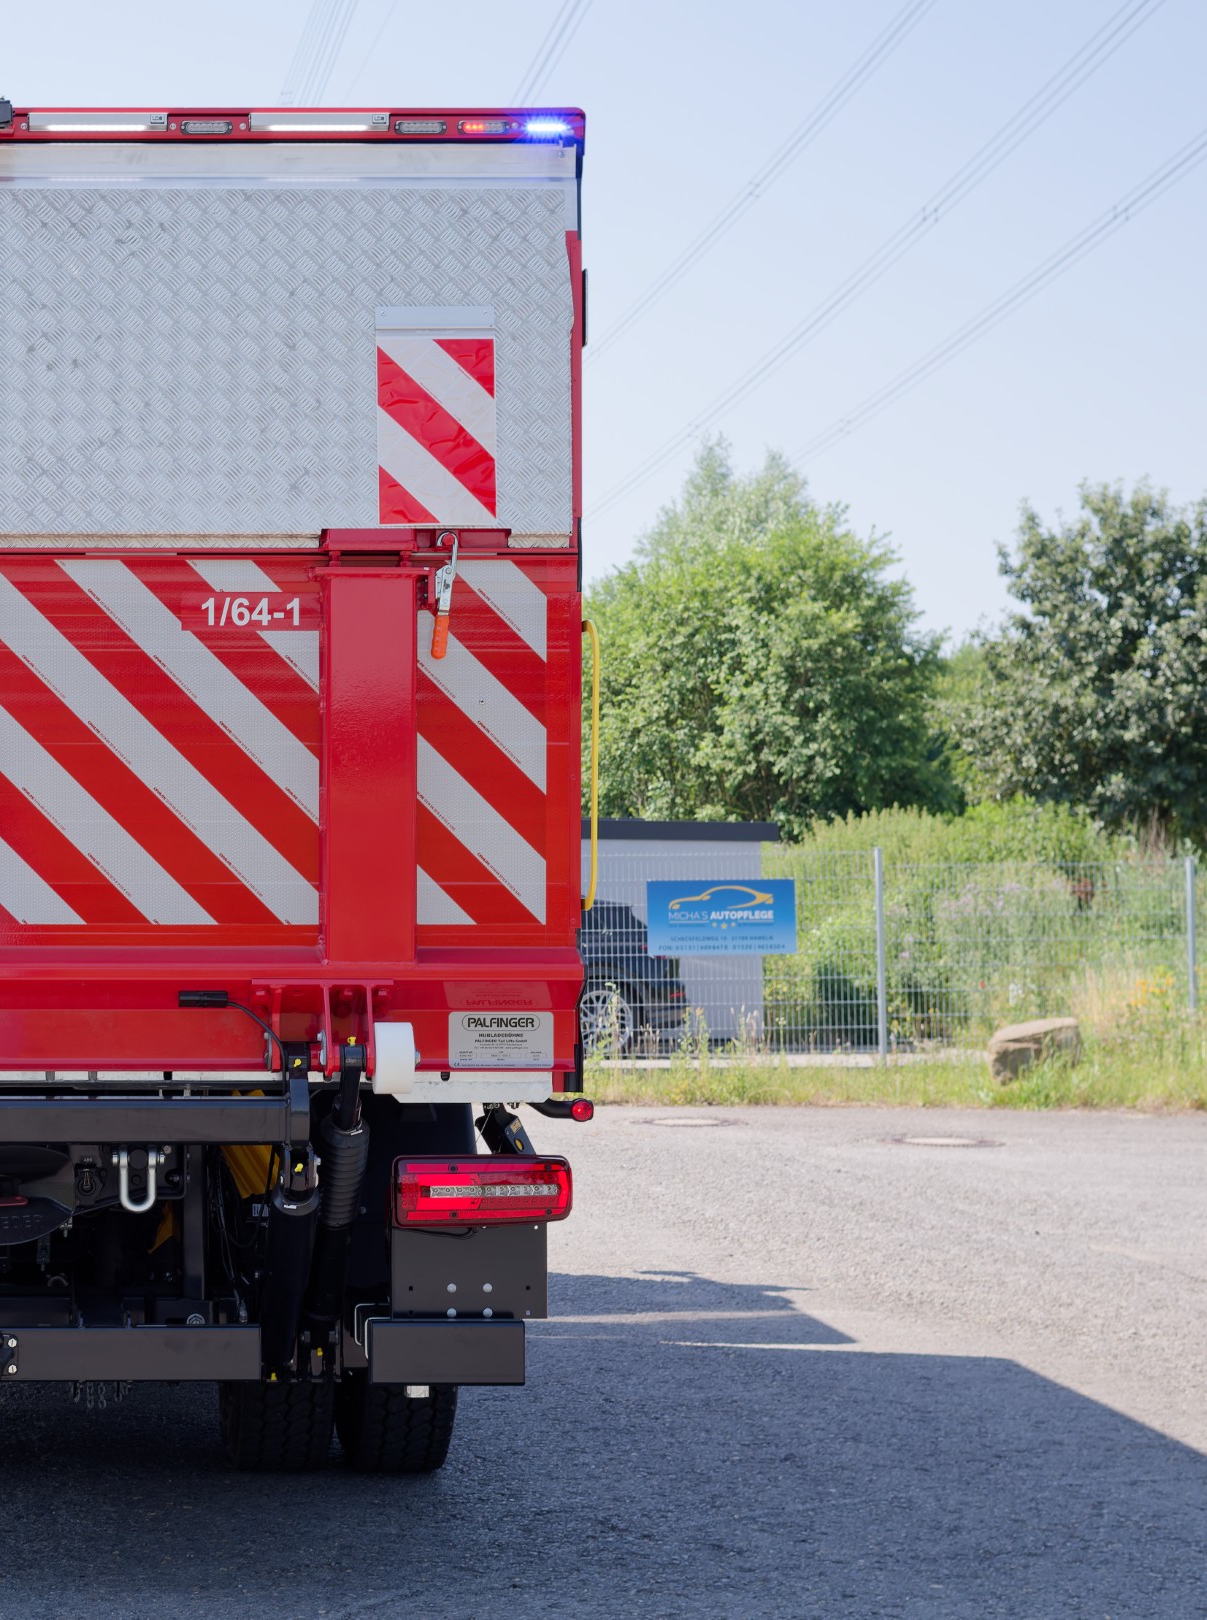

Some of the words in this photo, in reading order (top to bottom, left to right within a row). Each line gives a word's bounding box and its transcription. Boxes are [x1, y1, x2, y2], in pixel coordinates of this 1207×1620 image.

[201, 597, 300, 626] 1/64-1
[710, 910, 773, 920] AUTOPFLEGE
[467, 1017, 535, 1028] PALFINGER
